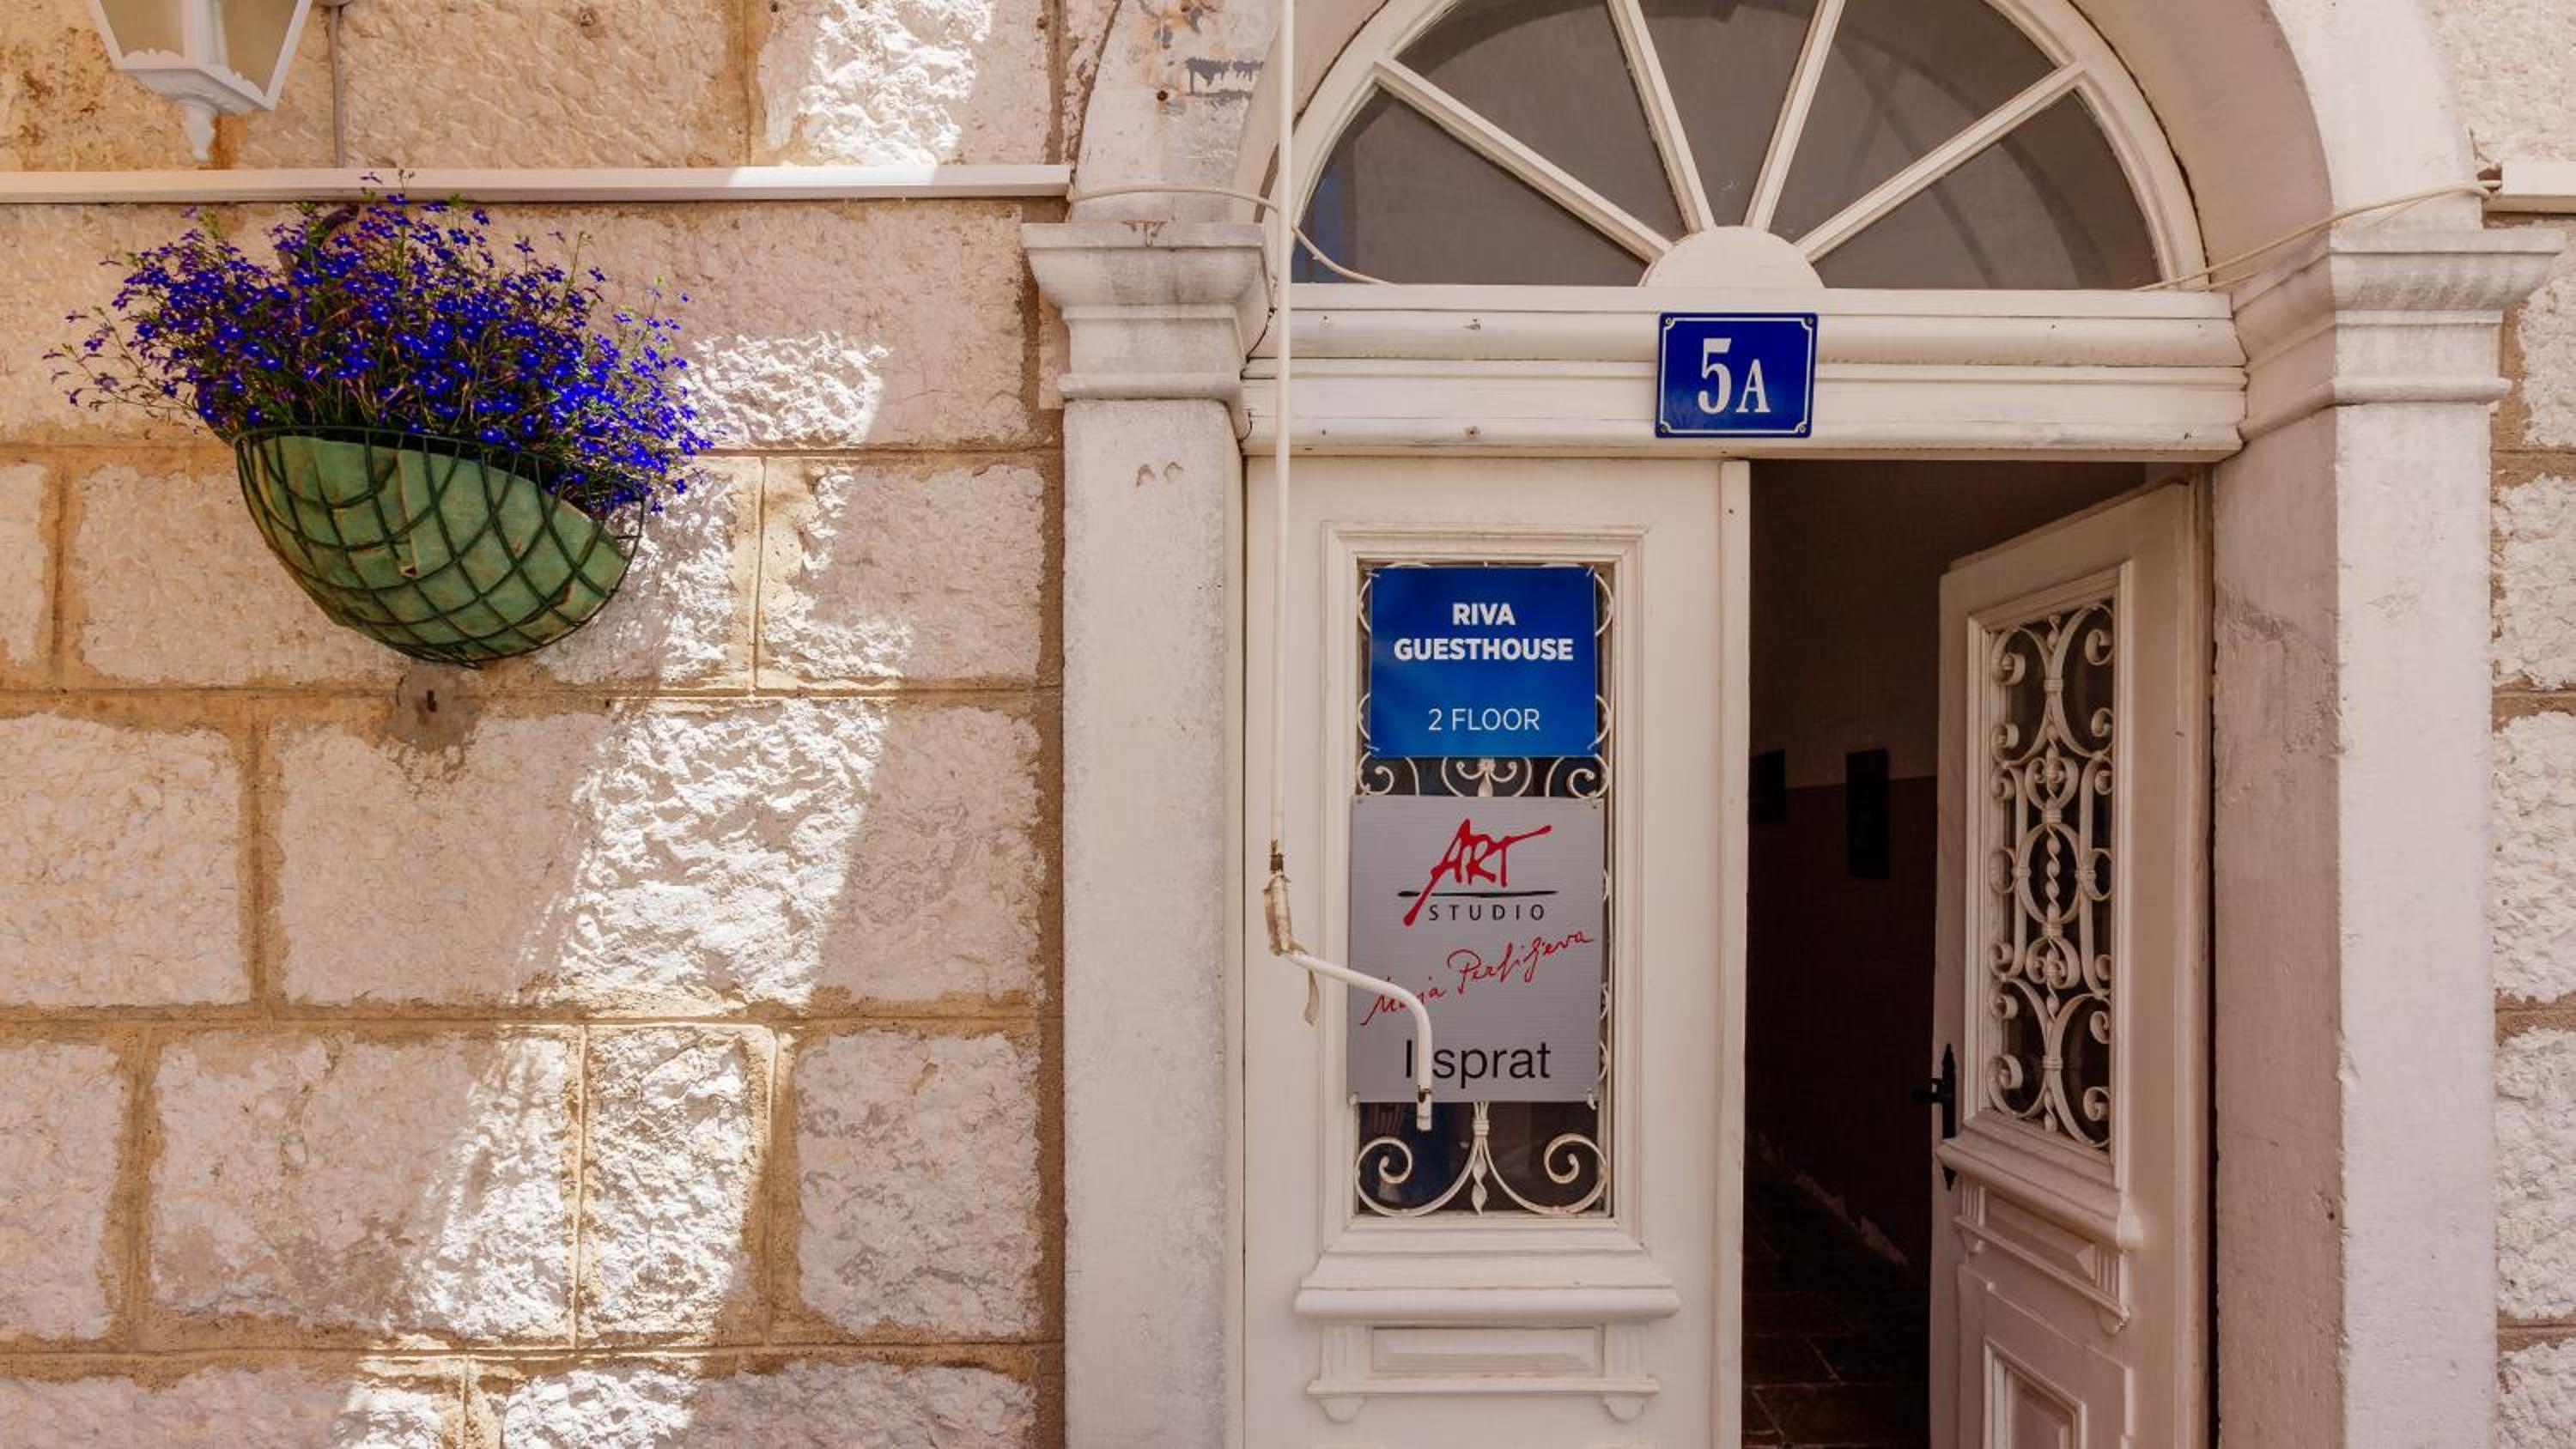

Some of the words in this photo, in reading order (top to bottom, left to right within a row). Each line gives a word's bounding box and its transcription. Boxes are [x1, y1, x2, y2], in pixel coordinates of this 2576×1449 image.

[1698, 337, 1771, 415] 5A
[1452, 603, 1516, 626] RIVA
[1394, 638, 1574, 661] GUESTHOUSE
[1428, 708, 1443, 731] 2
[1452, 708, 1540, 731] FLOOR
[1402, 818, 1553, 927] ART
[1428, 904, 1545, 921] STUDIO
[1431, 1041, 1552, 1088] sprat
